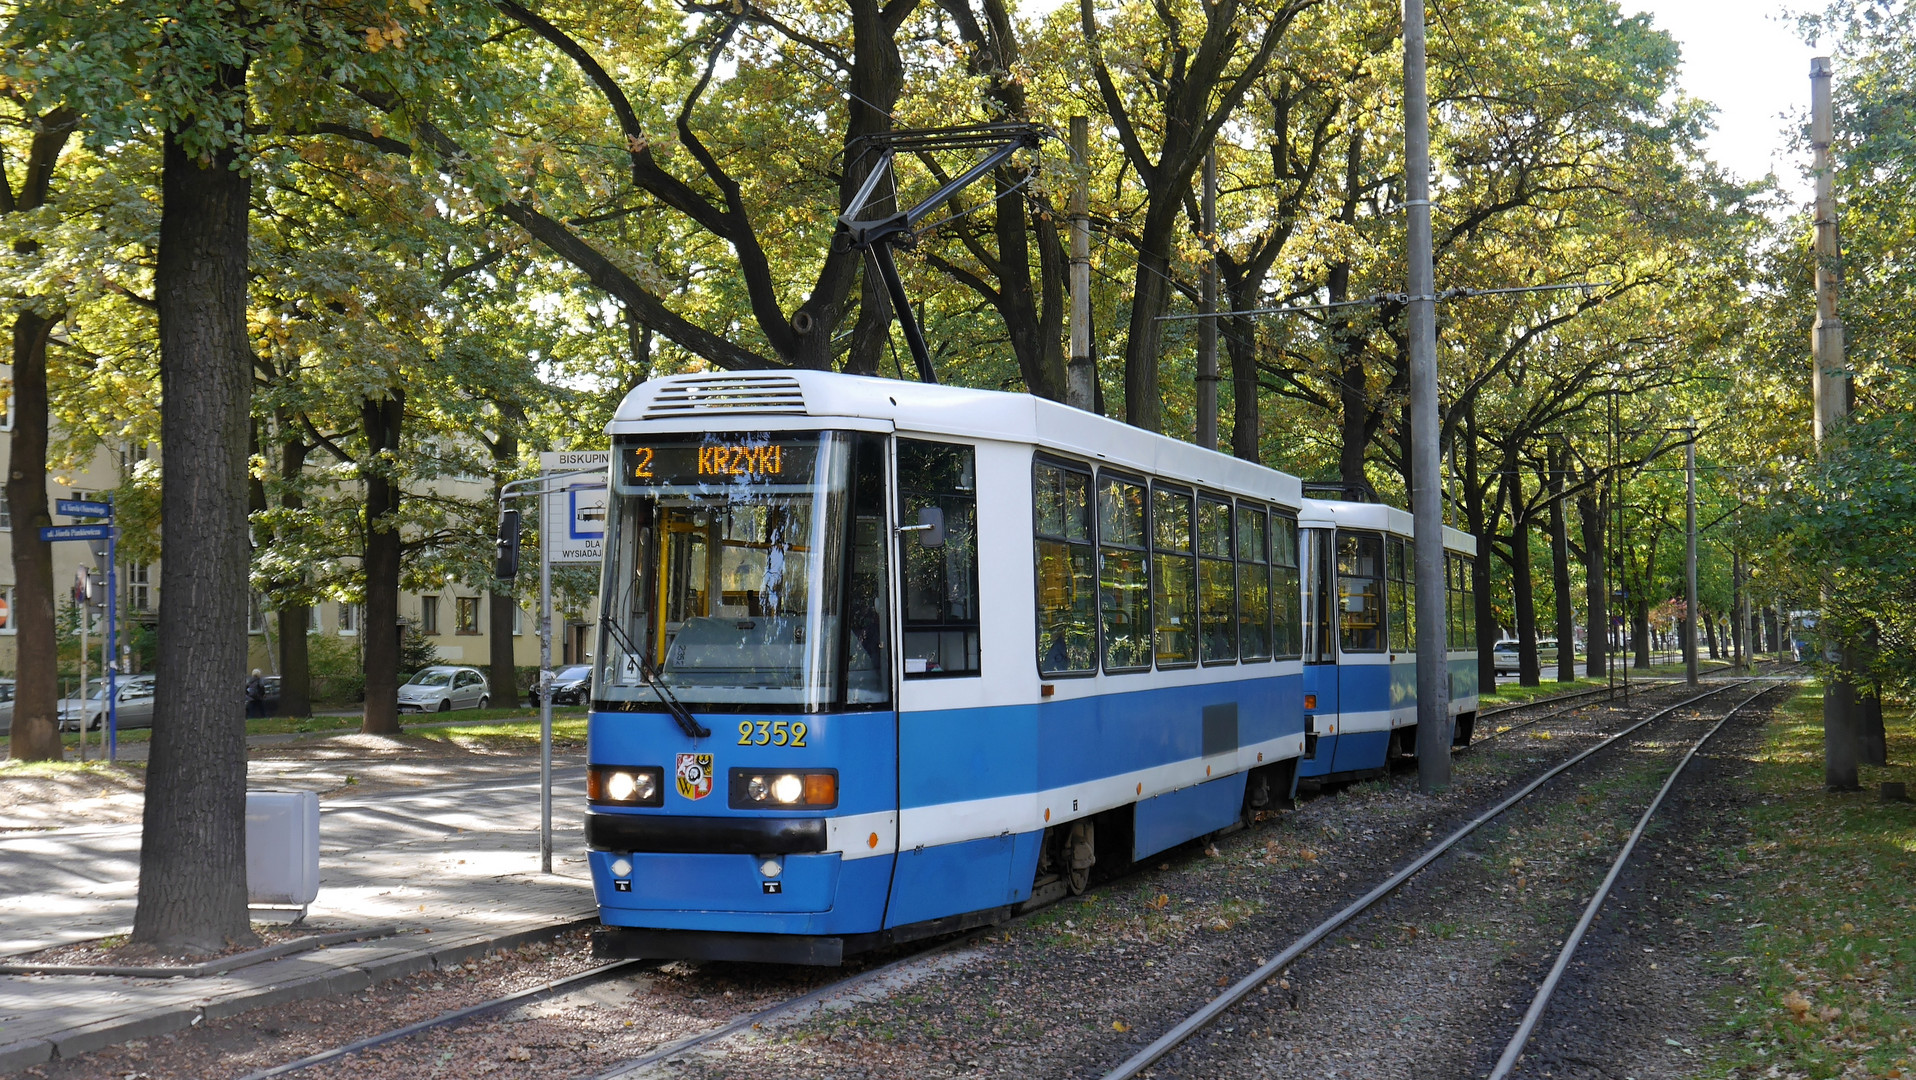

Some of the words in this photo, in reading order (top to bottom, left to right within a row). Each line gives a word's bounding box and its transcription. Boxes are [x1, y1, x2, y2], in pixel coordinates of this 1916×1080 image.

[559, 454, 609, 465] BISKUPIN
[634, 446, 655, 478] 2
[697, 445, 783, 475] KRZYKI
[585, 540, 601, 548] DLA
[626, 657, 635, 674] 4
[737, 720, 808, 748] 2352
